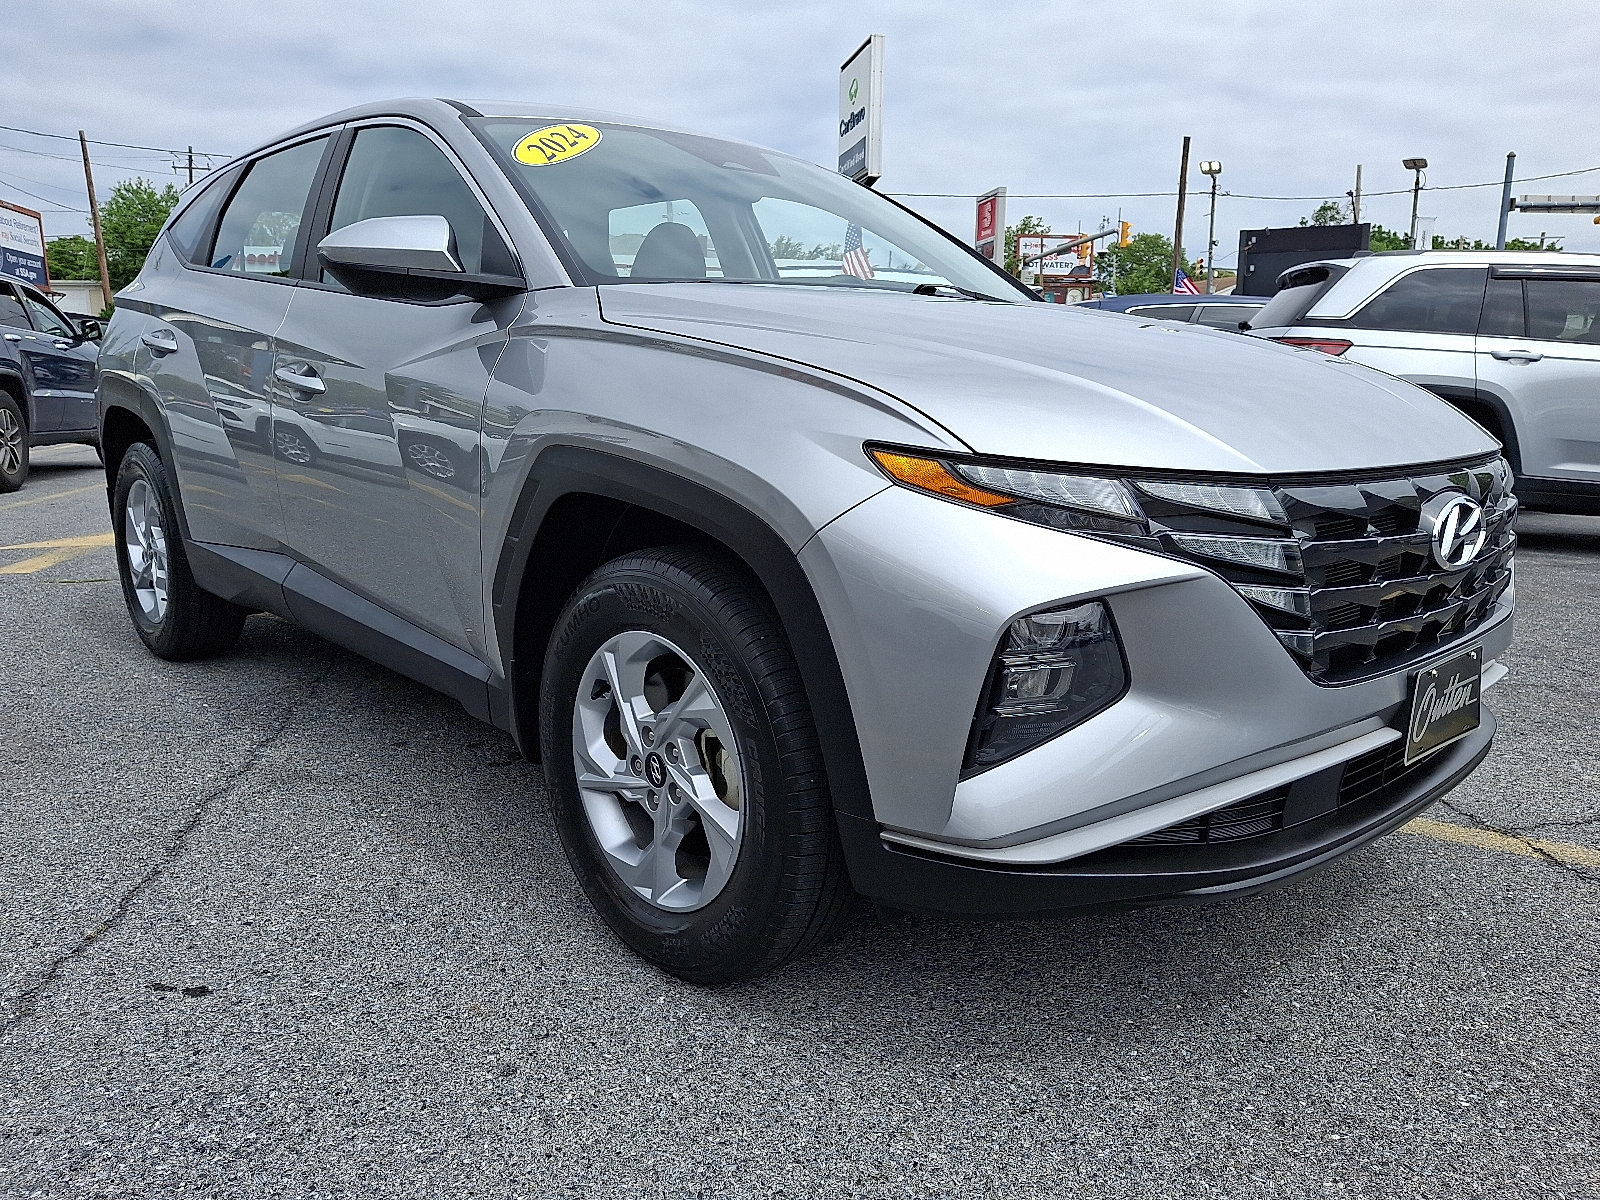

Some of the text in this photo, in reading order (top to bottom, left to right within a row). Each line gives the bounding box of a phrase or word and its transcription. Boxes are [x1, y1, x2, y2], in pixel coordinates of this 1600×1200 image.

[840, 106, 866, 138] CarBravo
[526, 125, 589, 162] 2024
[1043, 261, 1074, 269] WATER?
[556, 597, 601, 650] UMHO
[1413, 672, 1479, 743] Outten
